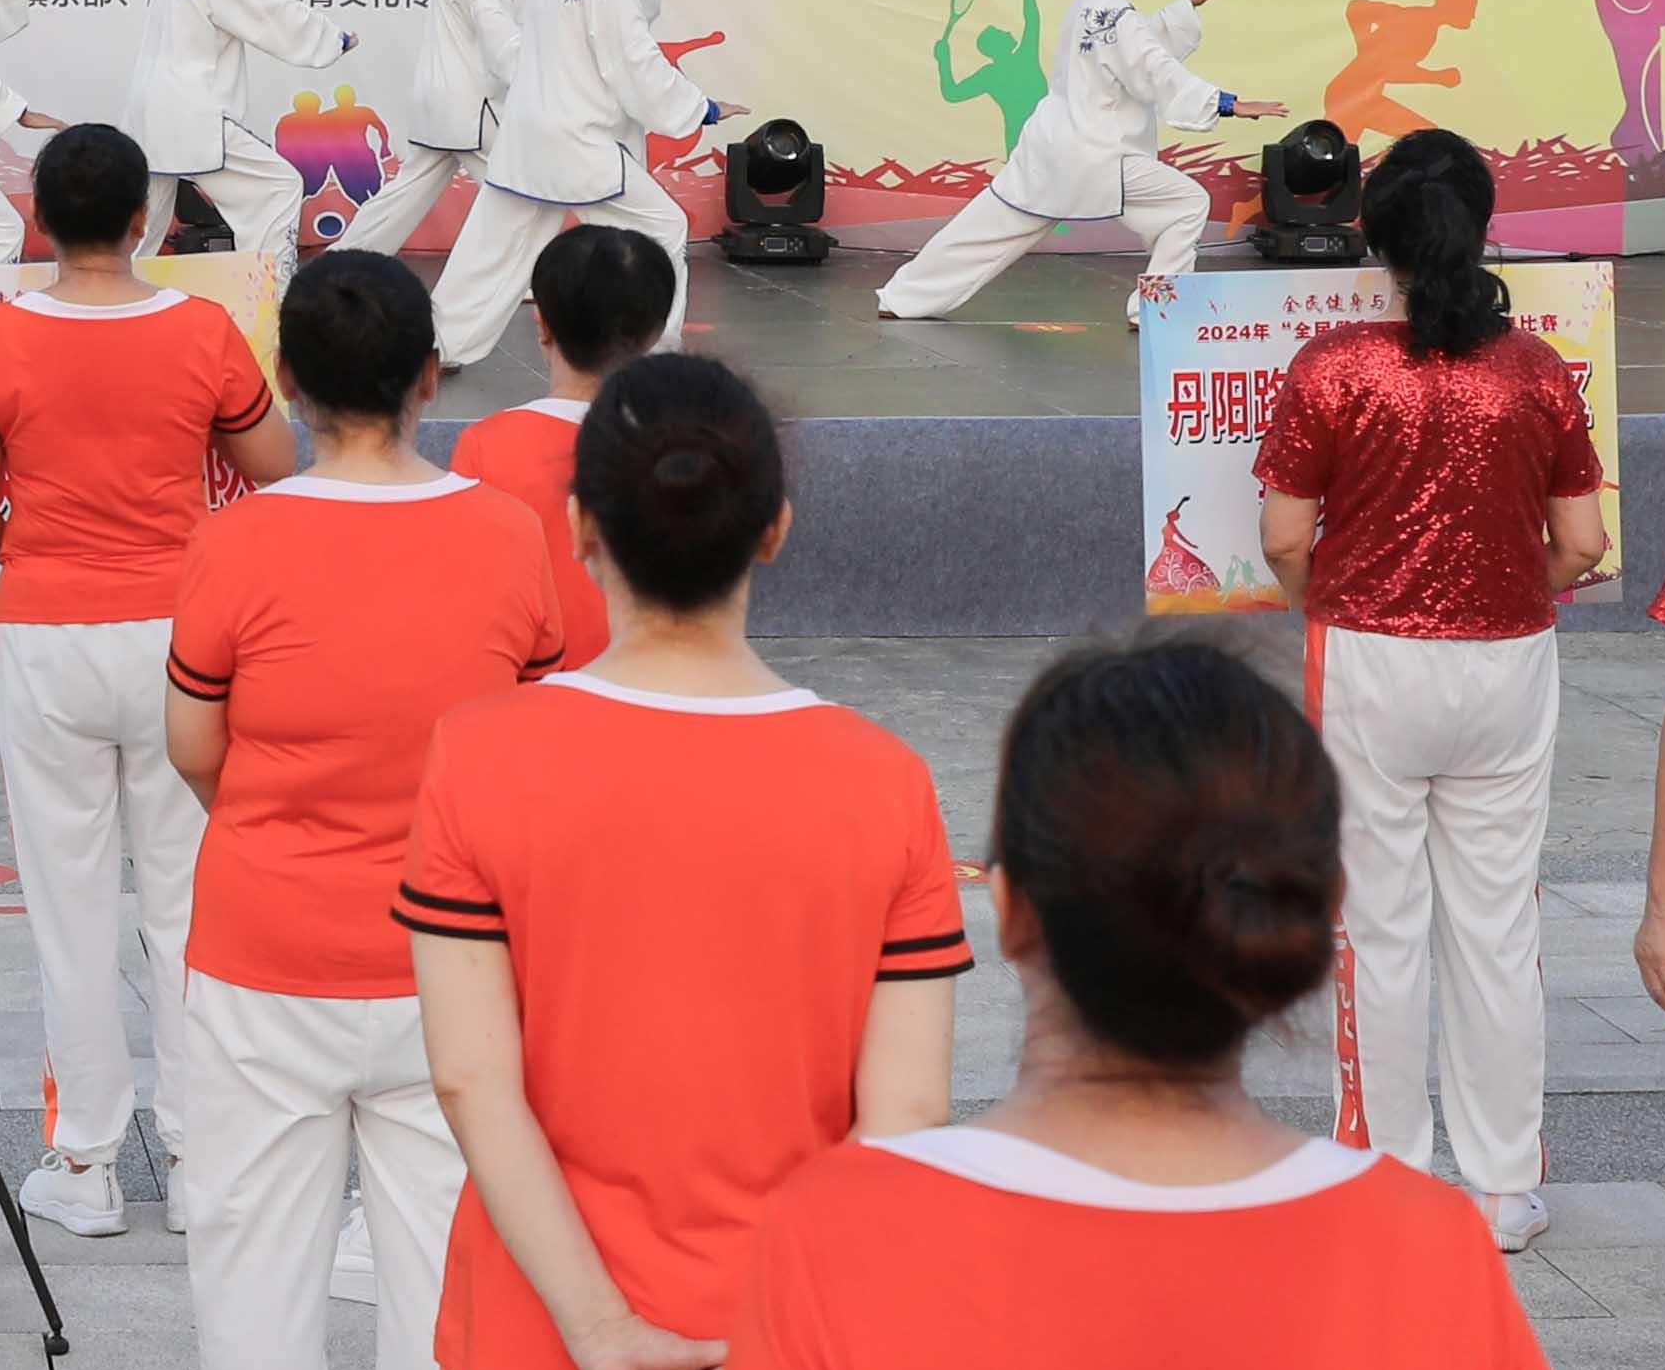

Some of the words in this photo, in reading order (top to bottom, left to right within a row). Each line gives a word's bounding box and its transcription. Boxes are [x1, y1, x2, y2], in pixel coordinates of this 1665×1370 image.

[1282, 294, 1386, 314] 全民健身与
